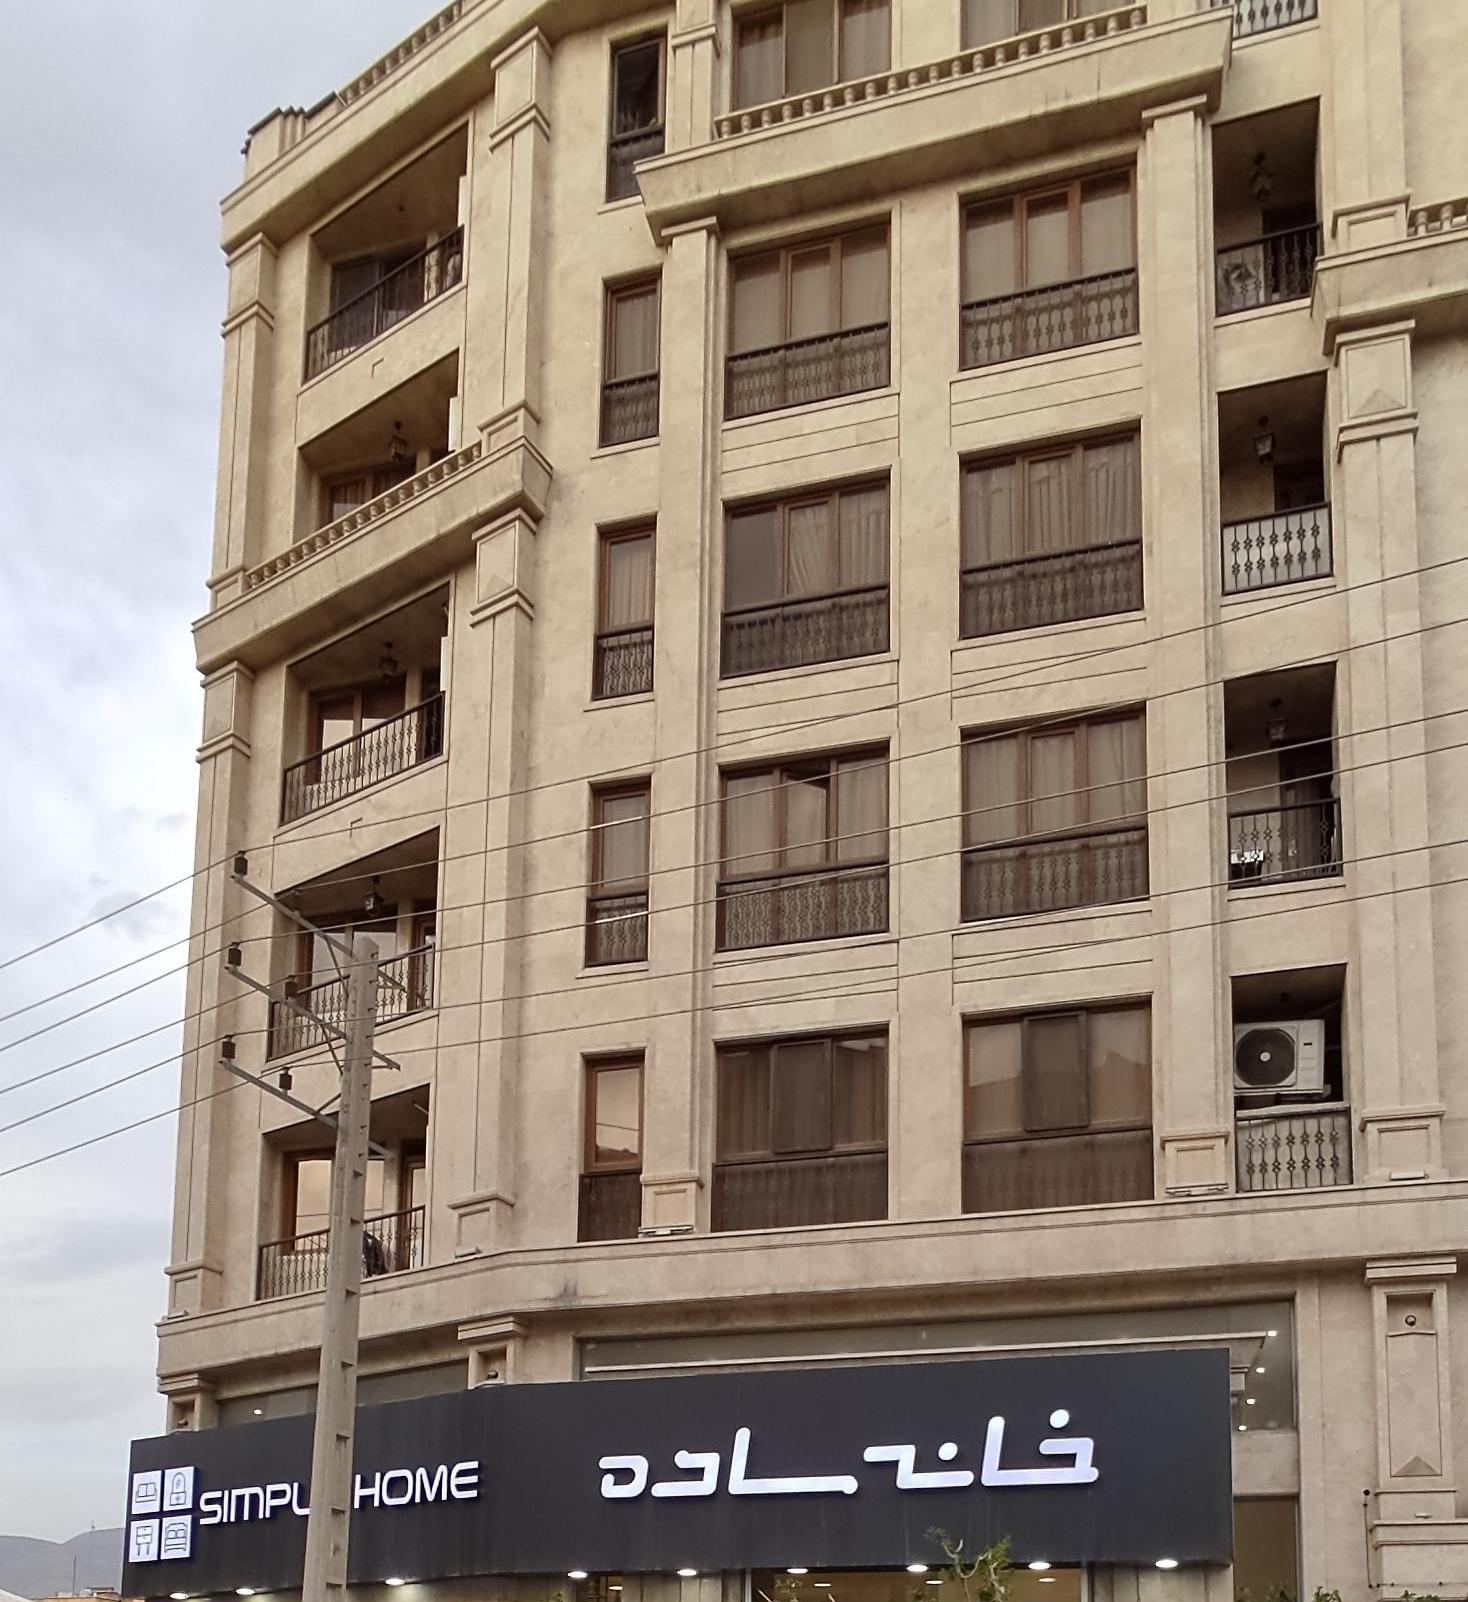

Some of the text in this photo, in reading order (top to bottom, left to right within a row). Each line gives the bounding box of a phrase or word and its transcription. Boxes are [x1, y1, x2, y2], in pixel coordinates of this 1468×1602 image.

[199, 1460, 479, 1525] SIMPL HOME
[598, 1409, 1099, 1499] خانه ساده
